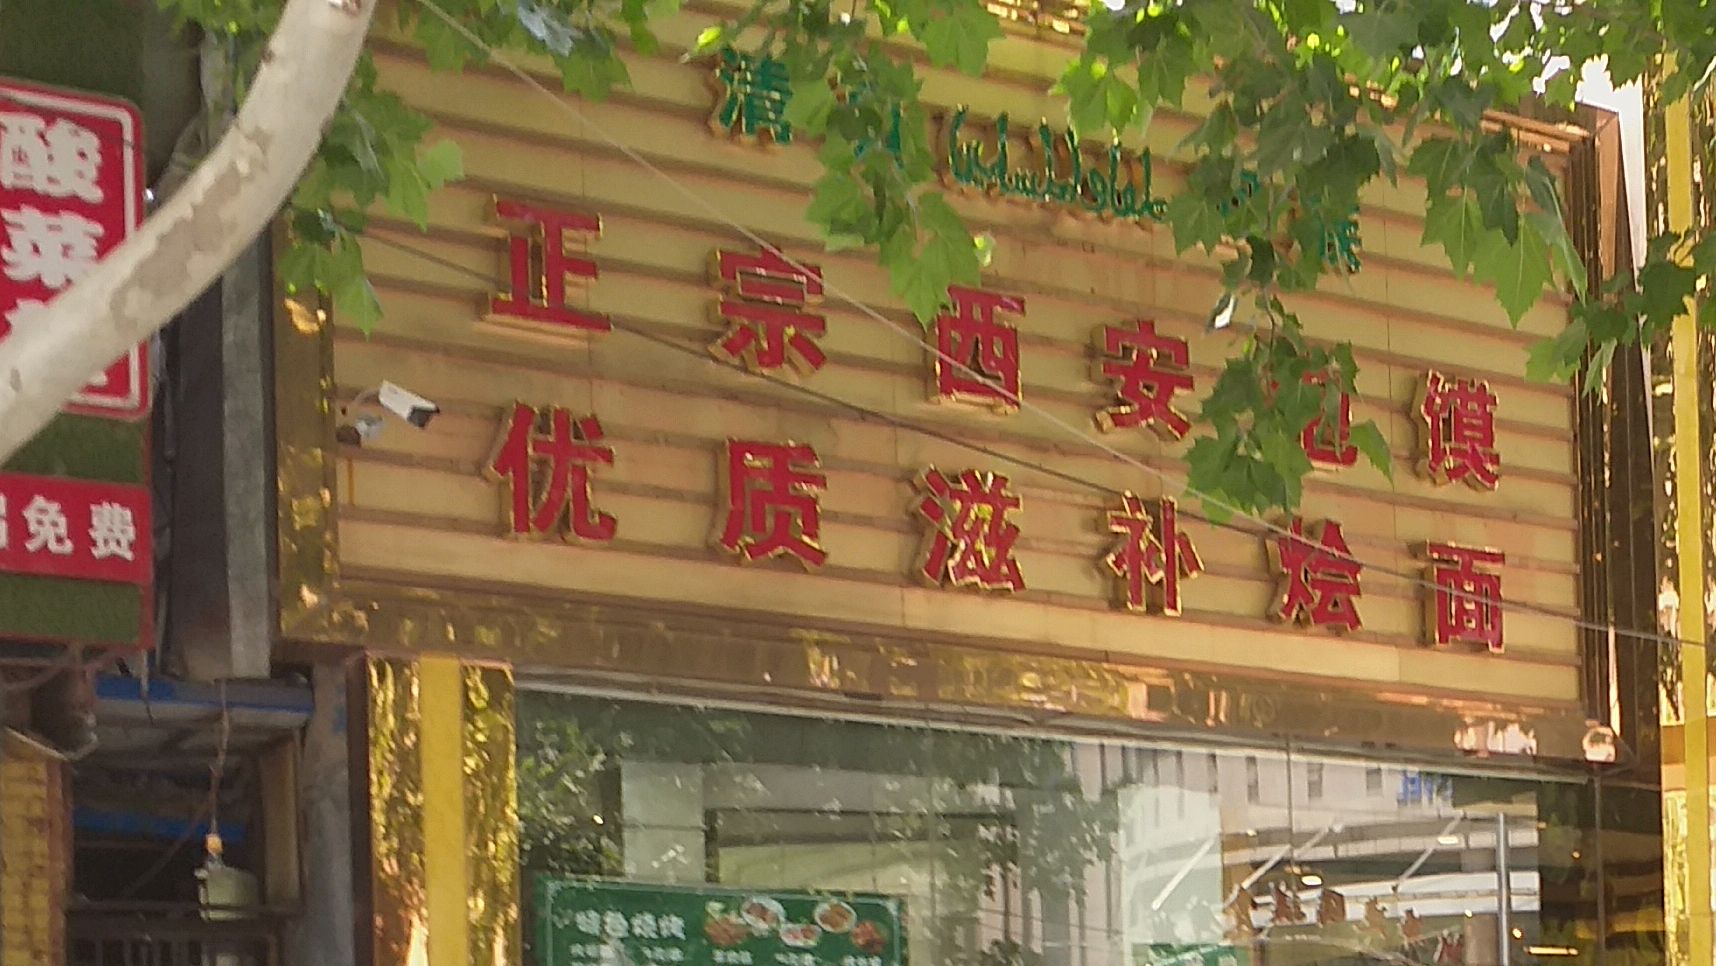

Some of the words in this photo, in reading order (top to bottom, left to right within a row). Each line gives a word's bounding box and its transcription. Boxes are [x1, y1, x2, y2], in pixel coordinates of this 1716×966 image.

[0, 493, 136, 562] 免费
[490, 402, 1506, 654] 优质滋补烩面
